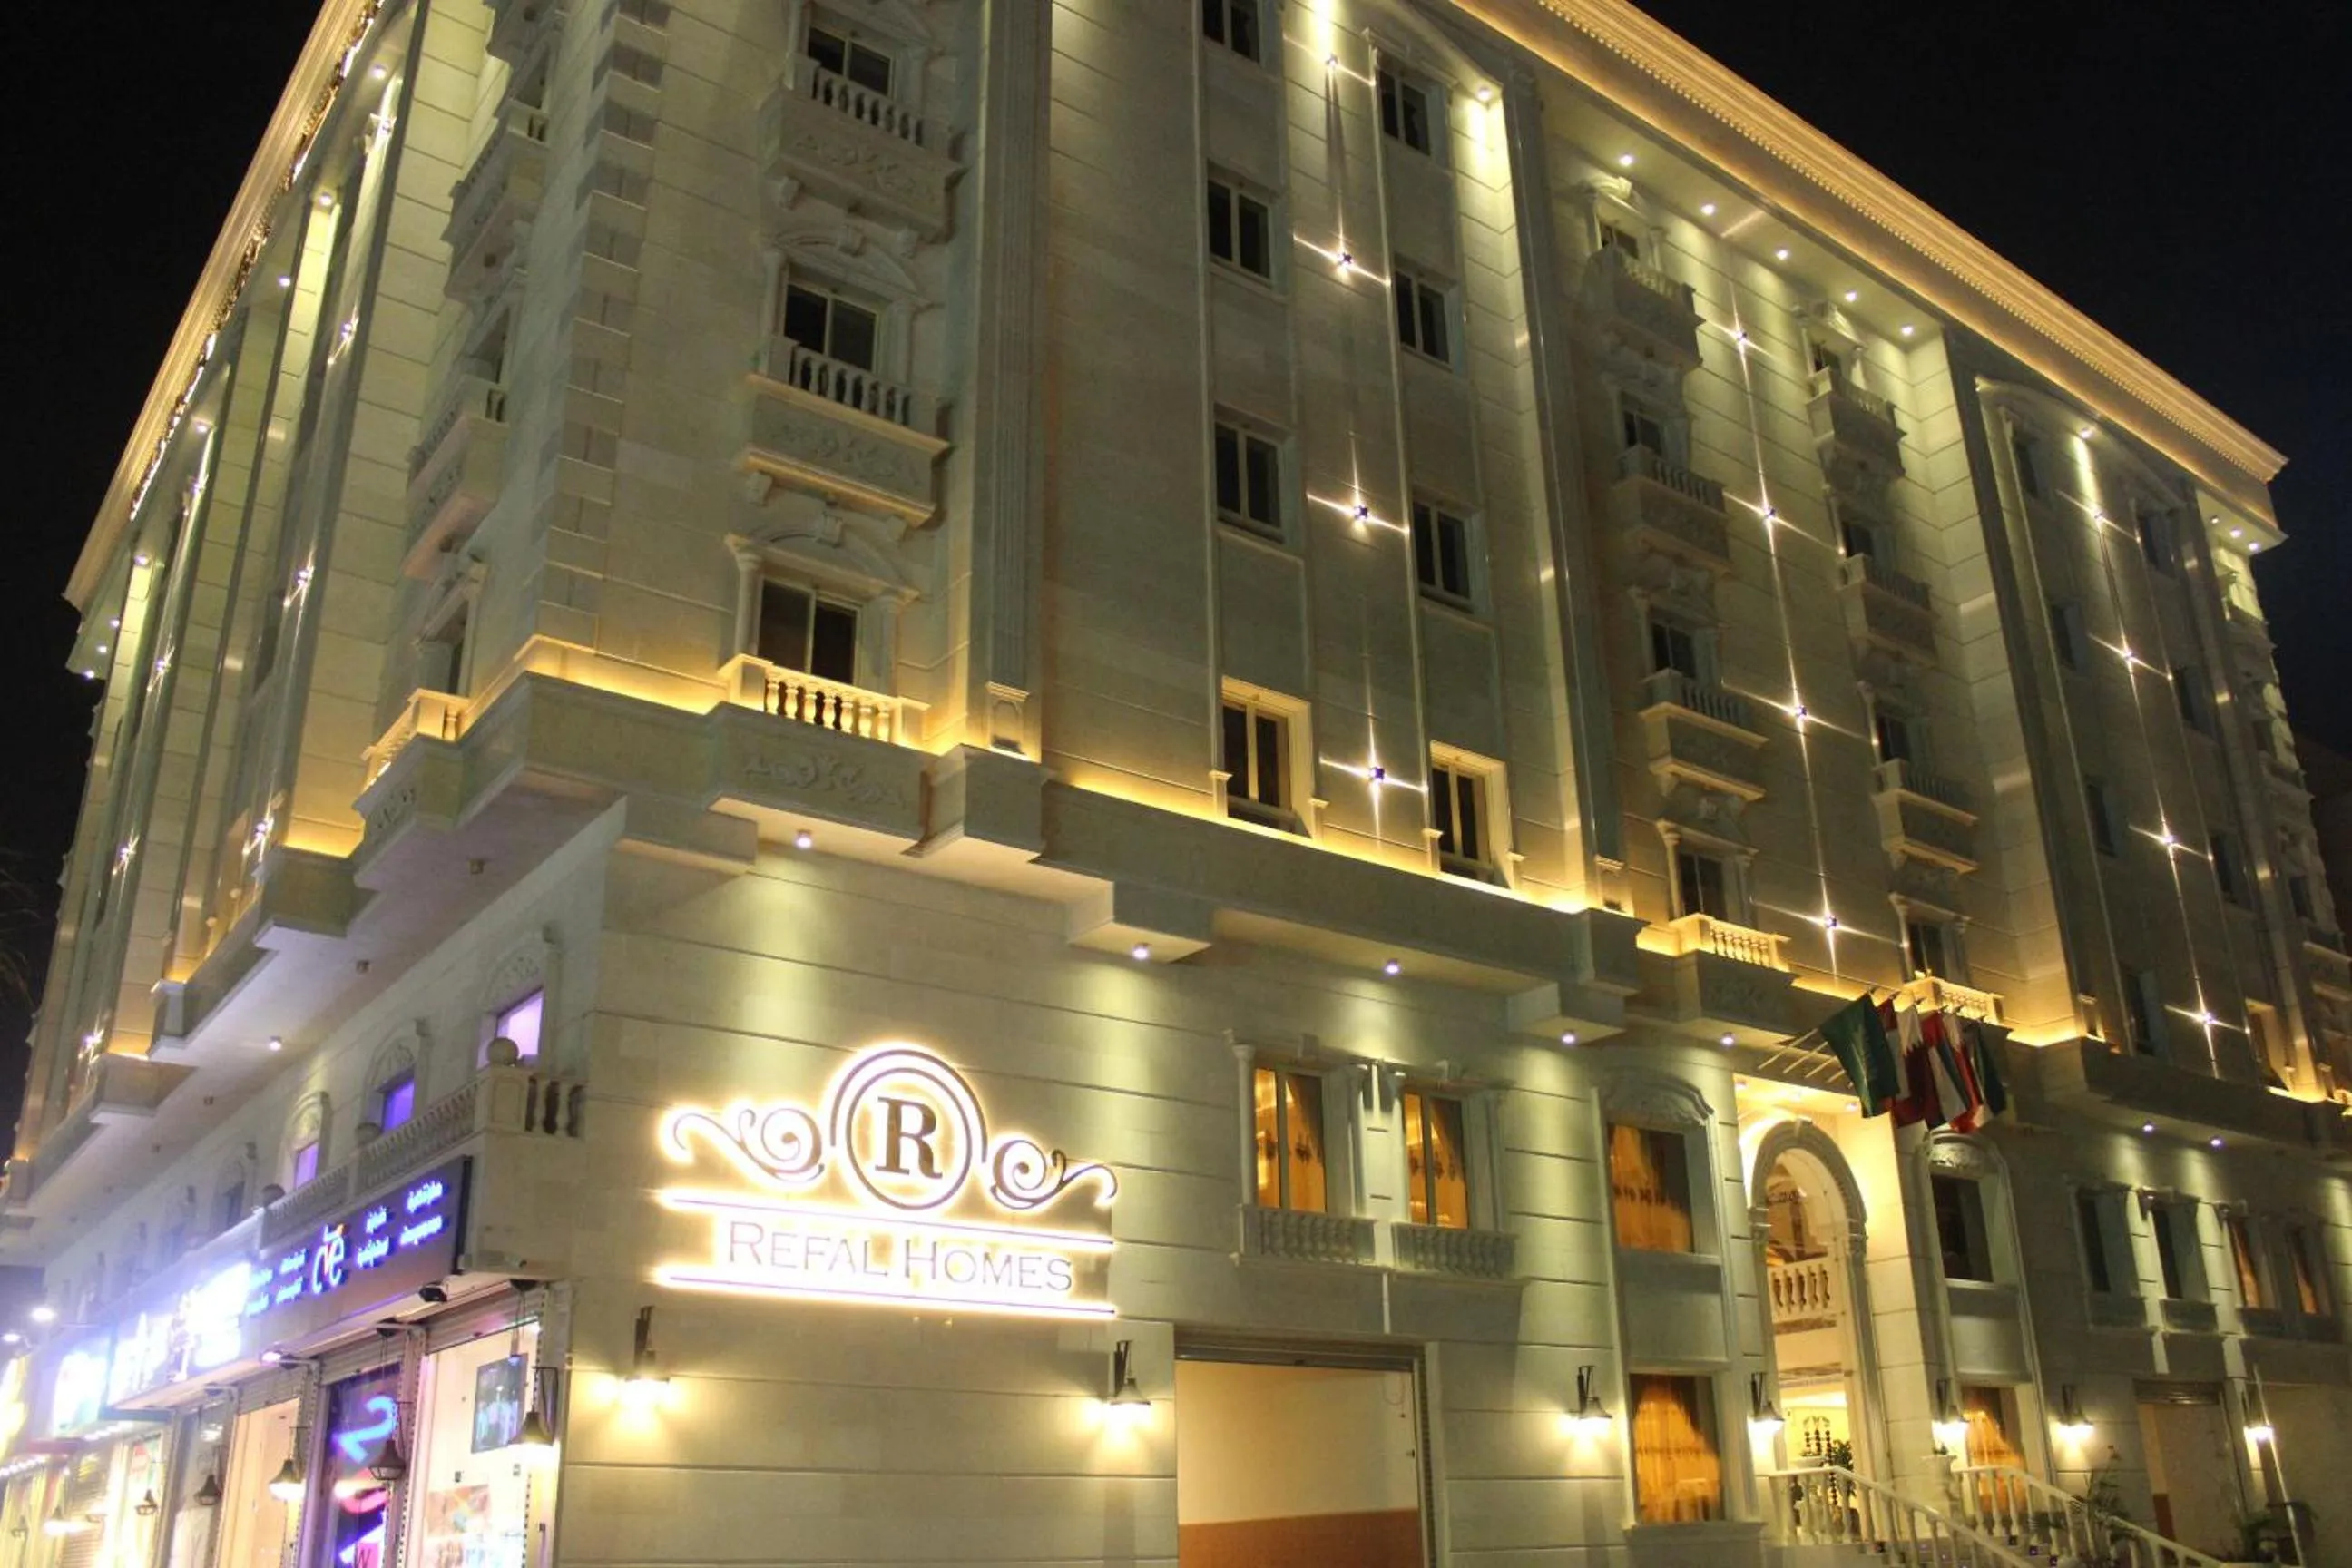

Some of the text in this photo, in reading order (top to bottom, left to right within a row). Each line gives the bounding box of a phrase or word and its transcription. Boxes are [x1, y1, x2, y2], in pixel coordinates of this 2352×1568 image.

[875, 1096, 942, 1179] R
[730, 1220, 1073, 1291] REFAL HOMES
